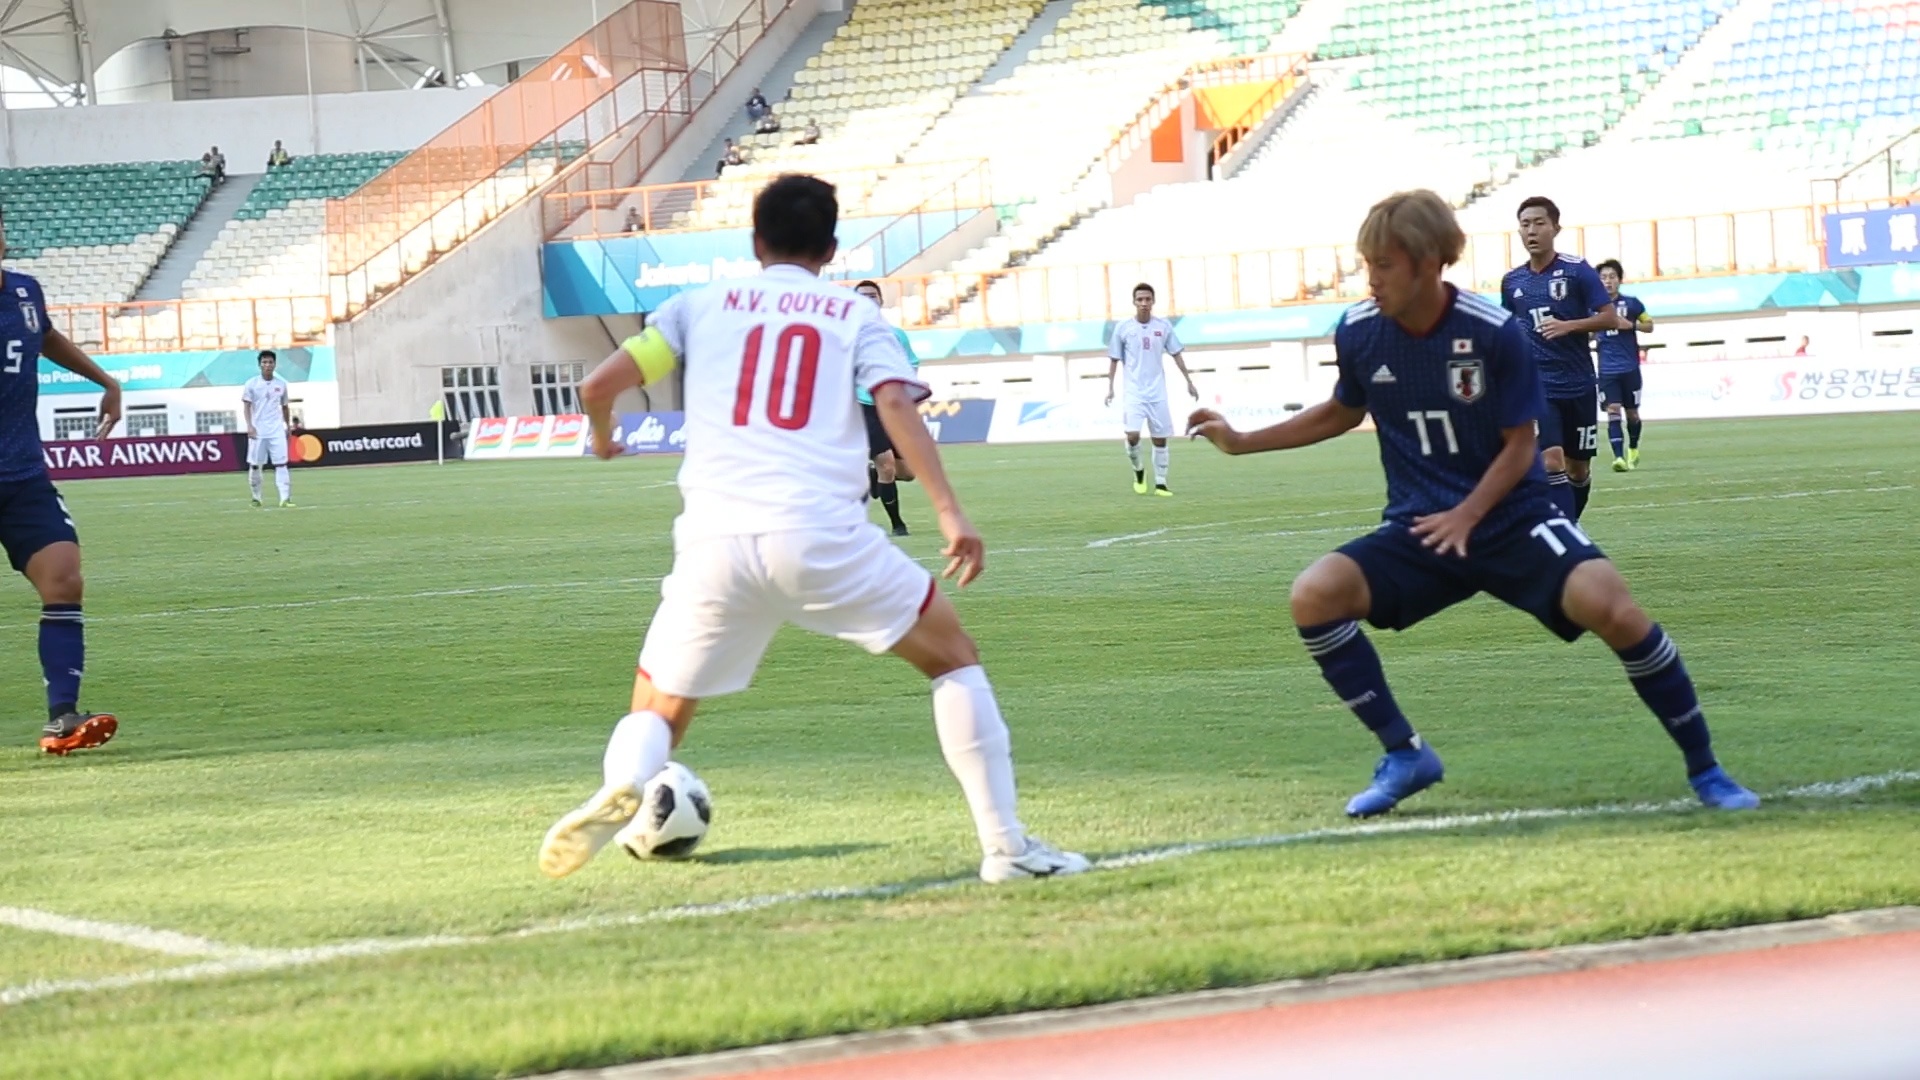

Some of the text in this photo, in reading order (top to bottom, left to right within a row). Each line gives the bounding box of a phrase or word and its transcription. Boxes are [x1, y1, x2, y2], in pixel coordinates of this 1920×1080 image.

[723, 290, 856, 320] N.V. QUYET
[732, 322, 821, 430] 10
[327, 432, 422, 452] mastercard
[1406, 410, 1460, 456] 17
[42, 440, 222, 469] ATAR AIRWAYS
[1529, 518, 1592, 556] 17
